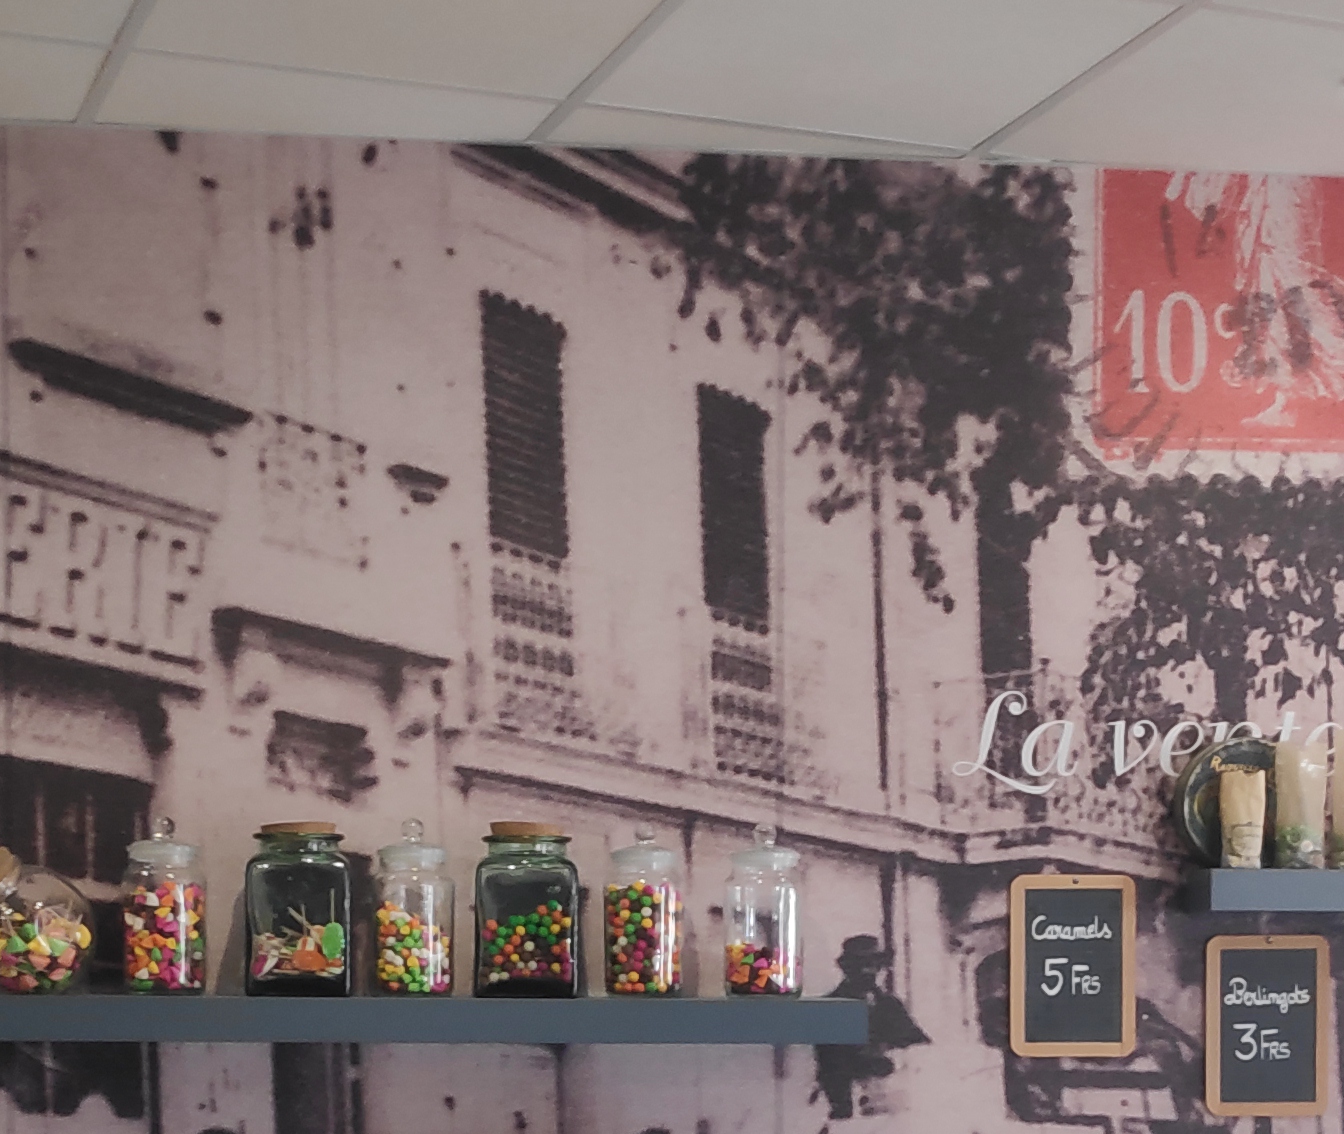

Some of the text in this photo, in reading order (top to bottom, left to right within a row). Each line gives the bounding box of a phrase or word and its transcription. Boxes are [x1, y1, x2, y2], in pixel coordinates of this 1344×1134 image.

[952, 690, 1078, 794] La
[1031, 915, 1113, 942] Caramels
[1040, 957, 1070, 997] 5
[1223, 976, 1312, 1014] Berlingots
[1233, 1022, 1259, 1062] 3
